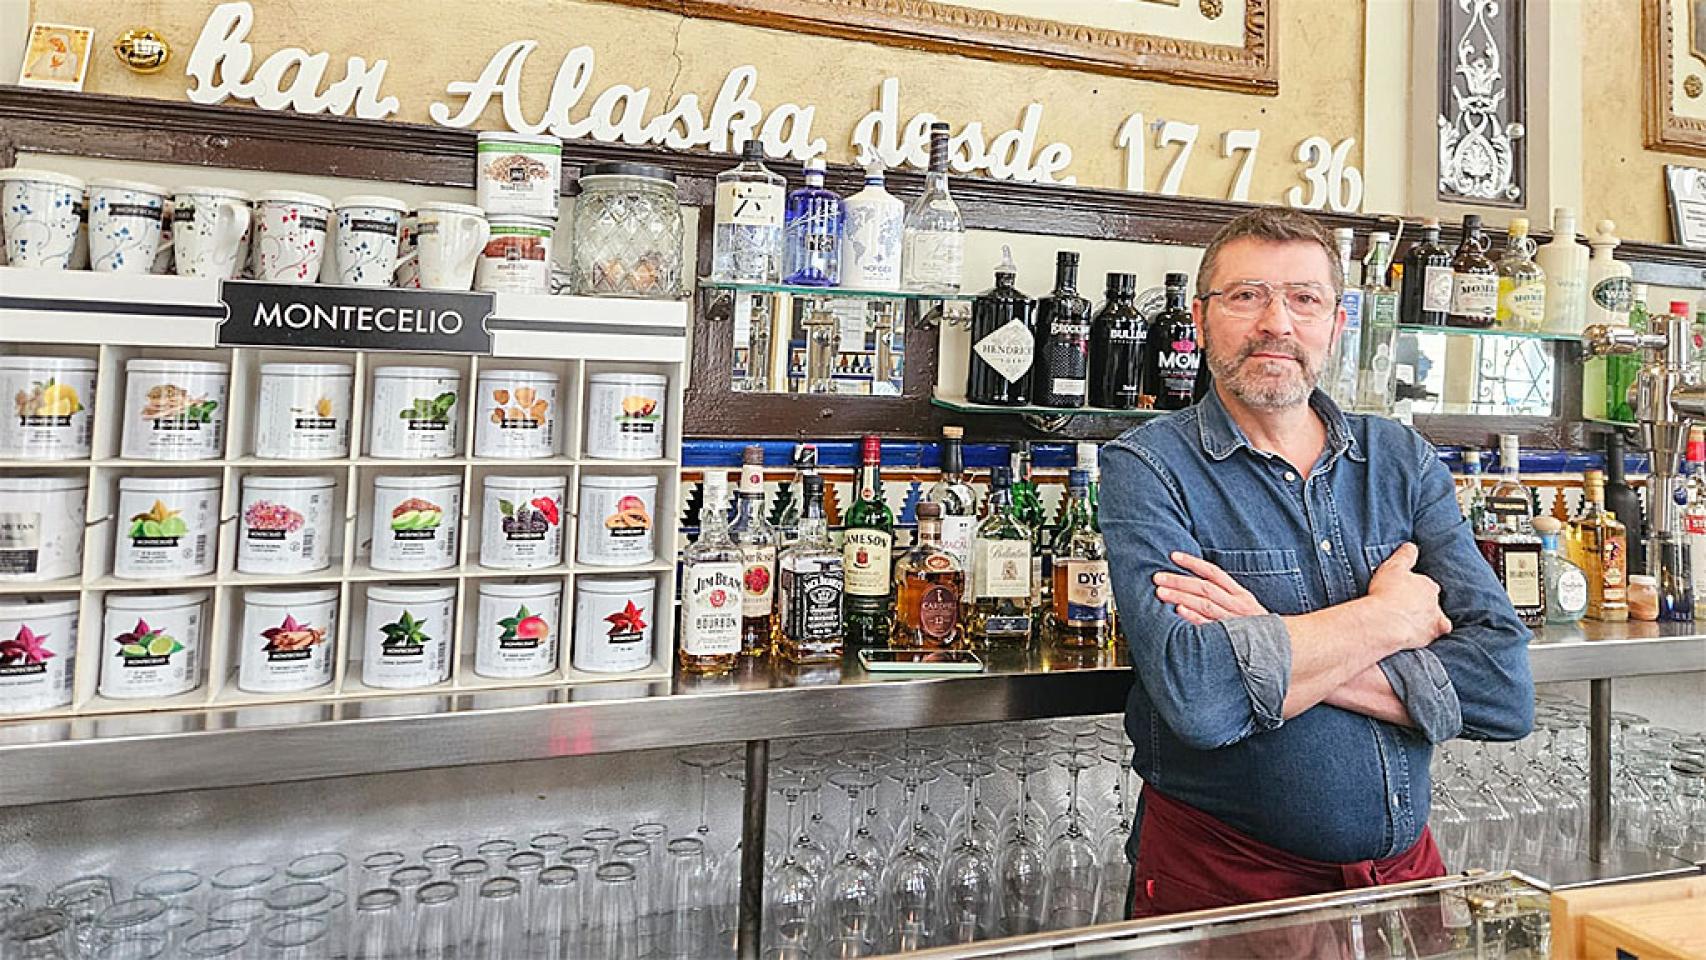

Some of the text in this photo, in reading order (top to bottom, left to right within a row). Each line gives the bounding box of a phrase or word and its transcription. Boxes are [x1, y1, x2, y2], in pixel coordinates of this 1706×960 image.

[186, 2, 1362, 212] bar Alaska desde 17 7 36
[253, 301, 463, 336] MONTECELIO
